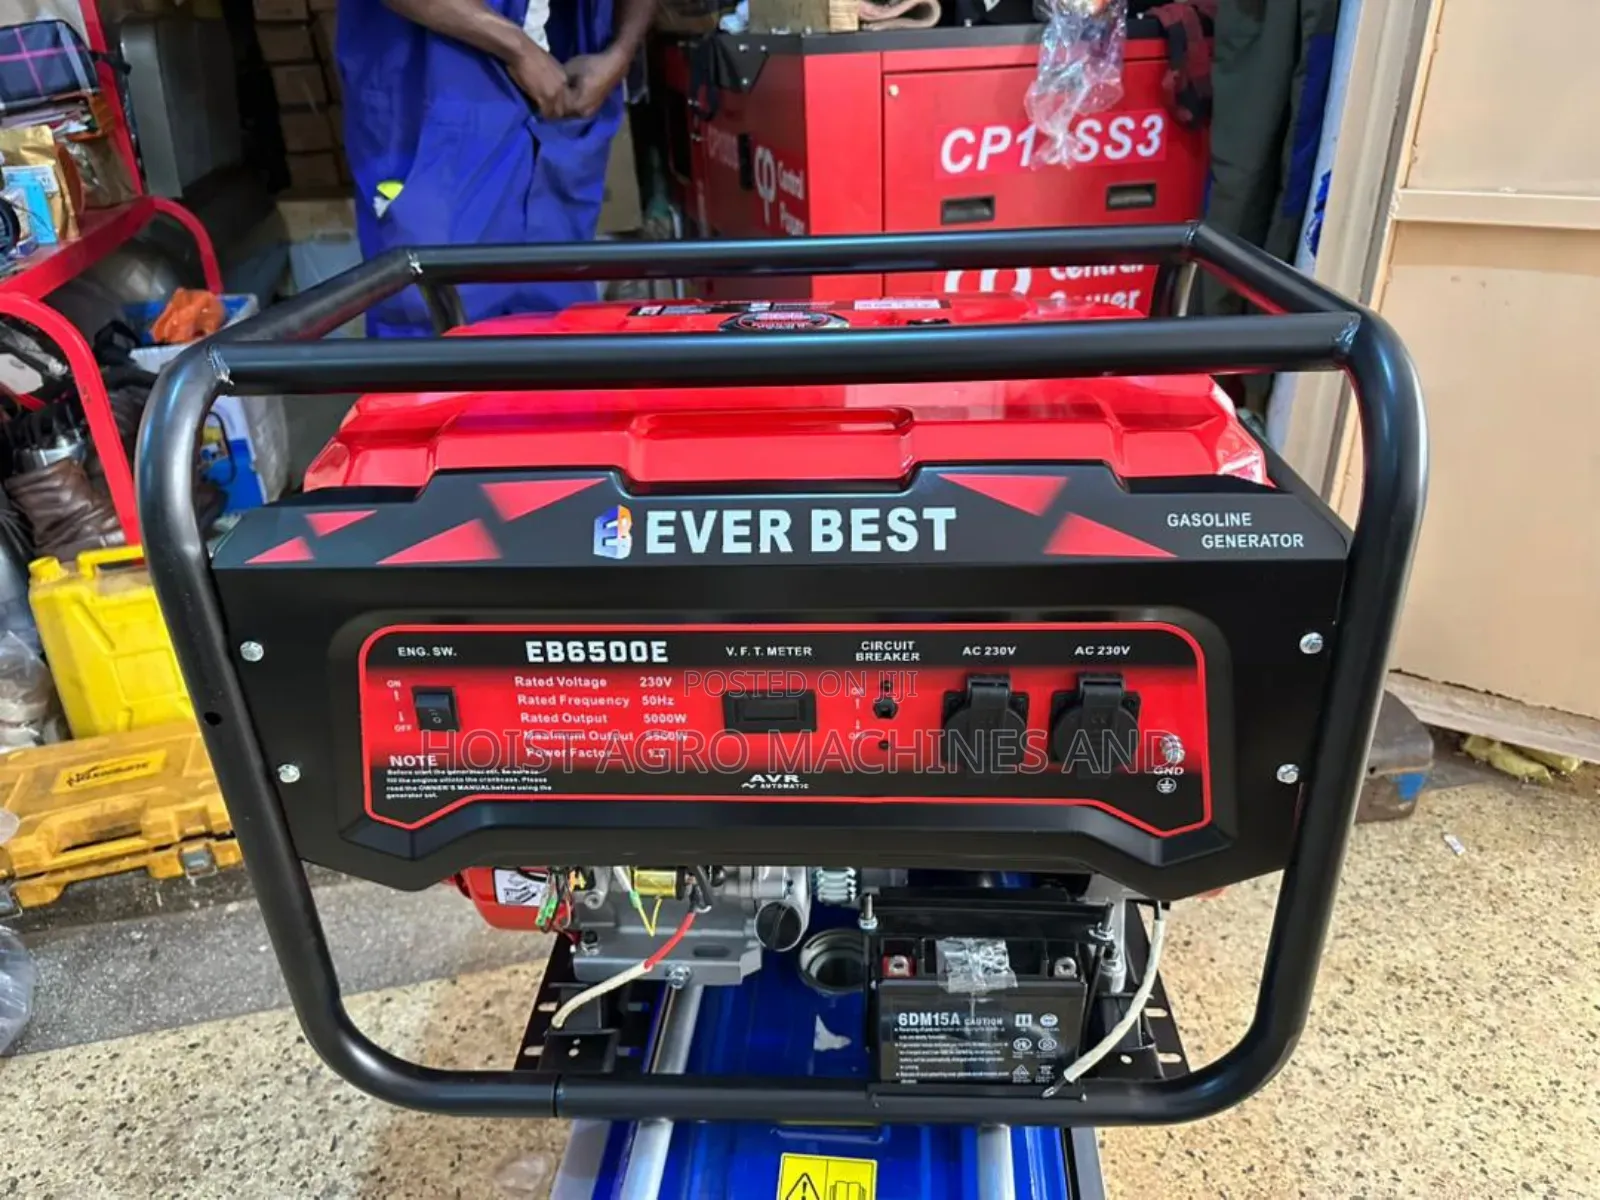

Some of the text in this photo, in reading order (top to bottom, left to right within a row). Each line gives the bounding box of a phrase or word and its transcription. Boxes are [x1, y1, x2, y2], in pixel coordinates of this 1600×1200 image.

[940, 114, 1165, 174] CP1SS3
[1167, 512, 1252, 527] GASOLINE
[646, 507, 957, 554] EVER BEST
[1201, 533, 1304, 548] GENERATOR
[397, 646, 457, 656] ENG. SW.
[525, 640, 668, 663] EB6500E
[767, 647, 812, 656] METER
[861, 641, 915, 651] CIRCUIT
[963, 646, 1017, 656] AC 230V
[1074, 646, 1130, 656] AC 230V
[855, 652, 920, 662] BREAKER
[514, 676, 673, 690] Rated Voltage 230V
[517, 694, 675, 708] Rated Frequency 50Hz
[520, 712, 688, 725] Rated Output 5000W
[588, 730, 634, 743] Output
[526, 747, 566, 759] Power
[570, 747, 612, 758] Factor
[389, 755, 438, 767] NOTE
[1153, 766, 1185, 777] GND
[749, 773, 800, 784] AVR
[898, 1012, 1003, 1026] 6DM15A CAUTION
